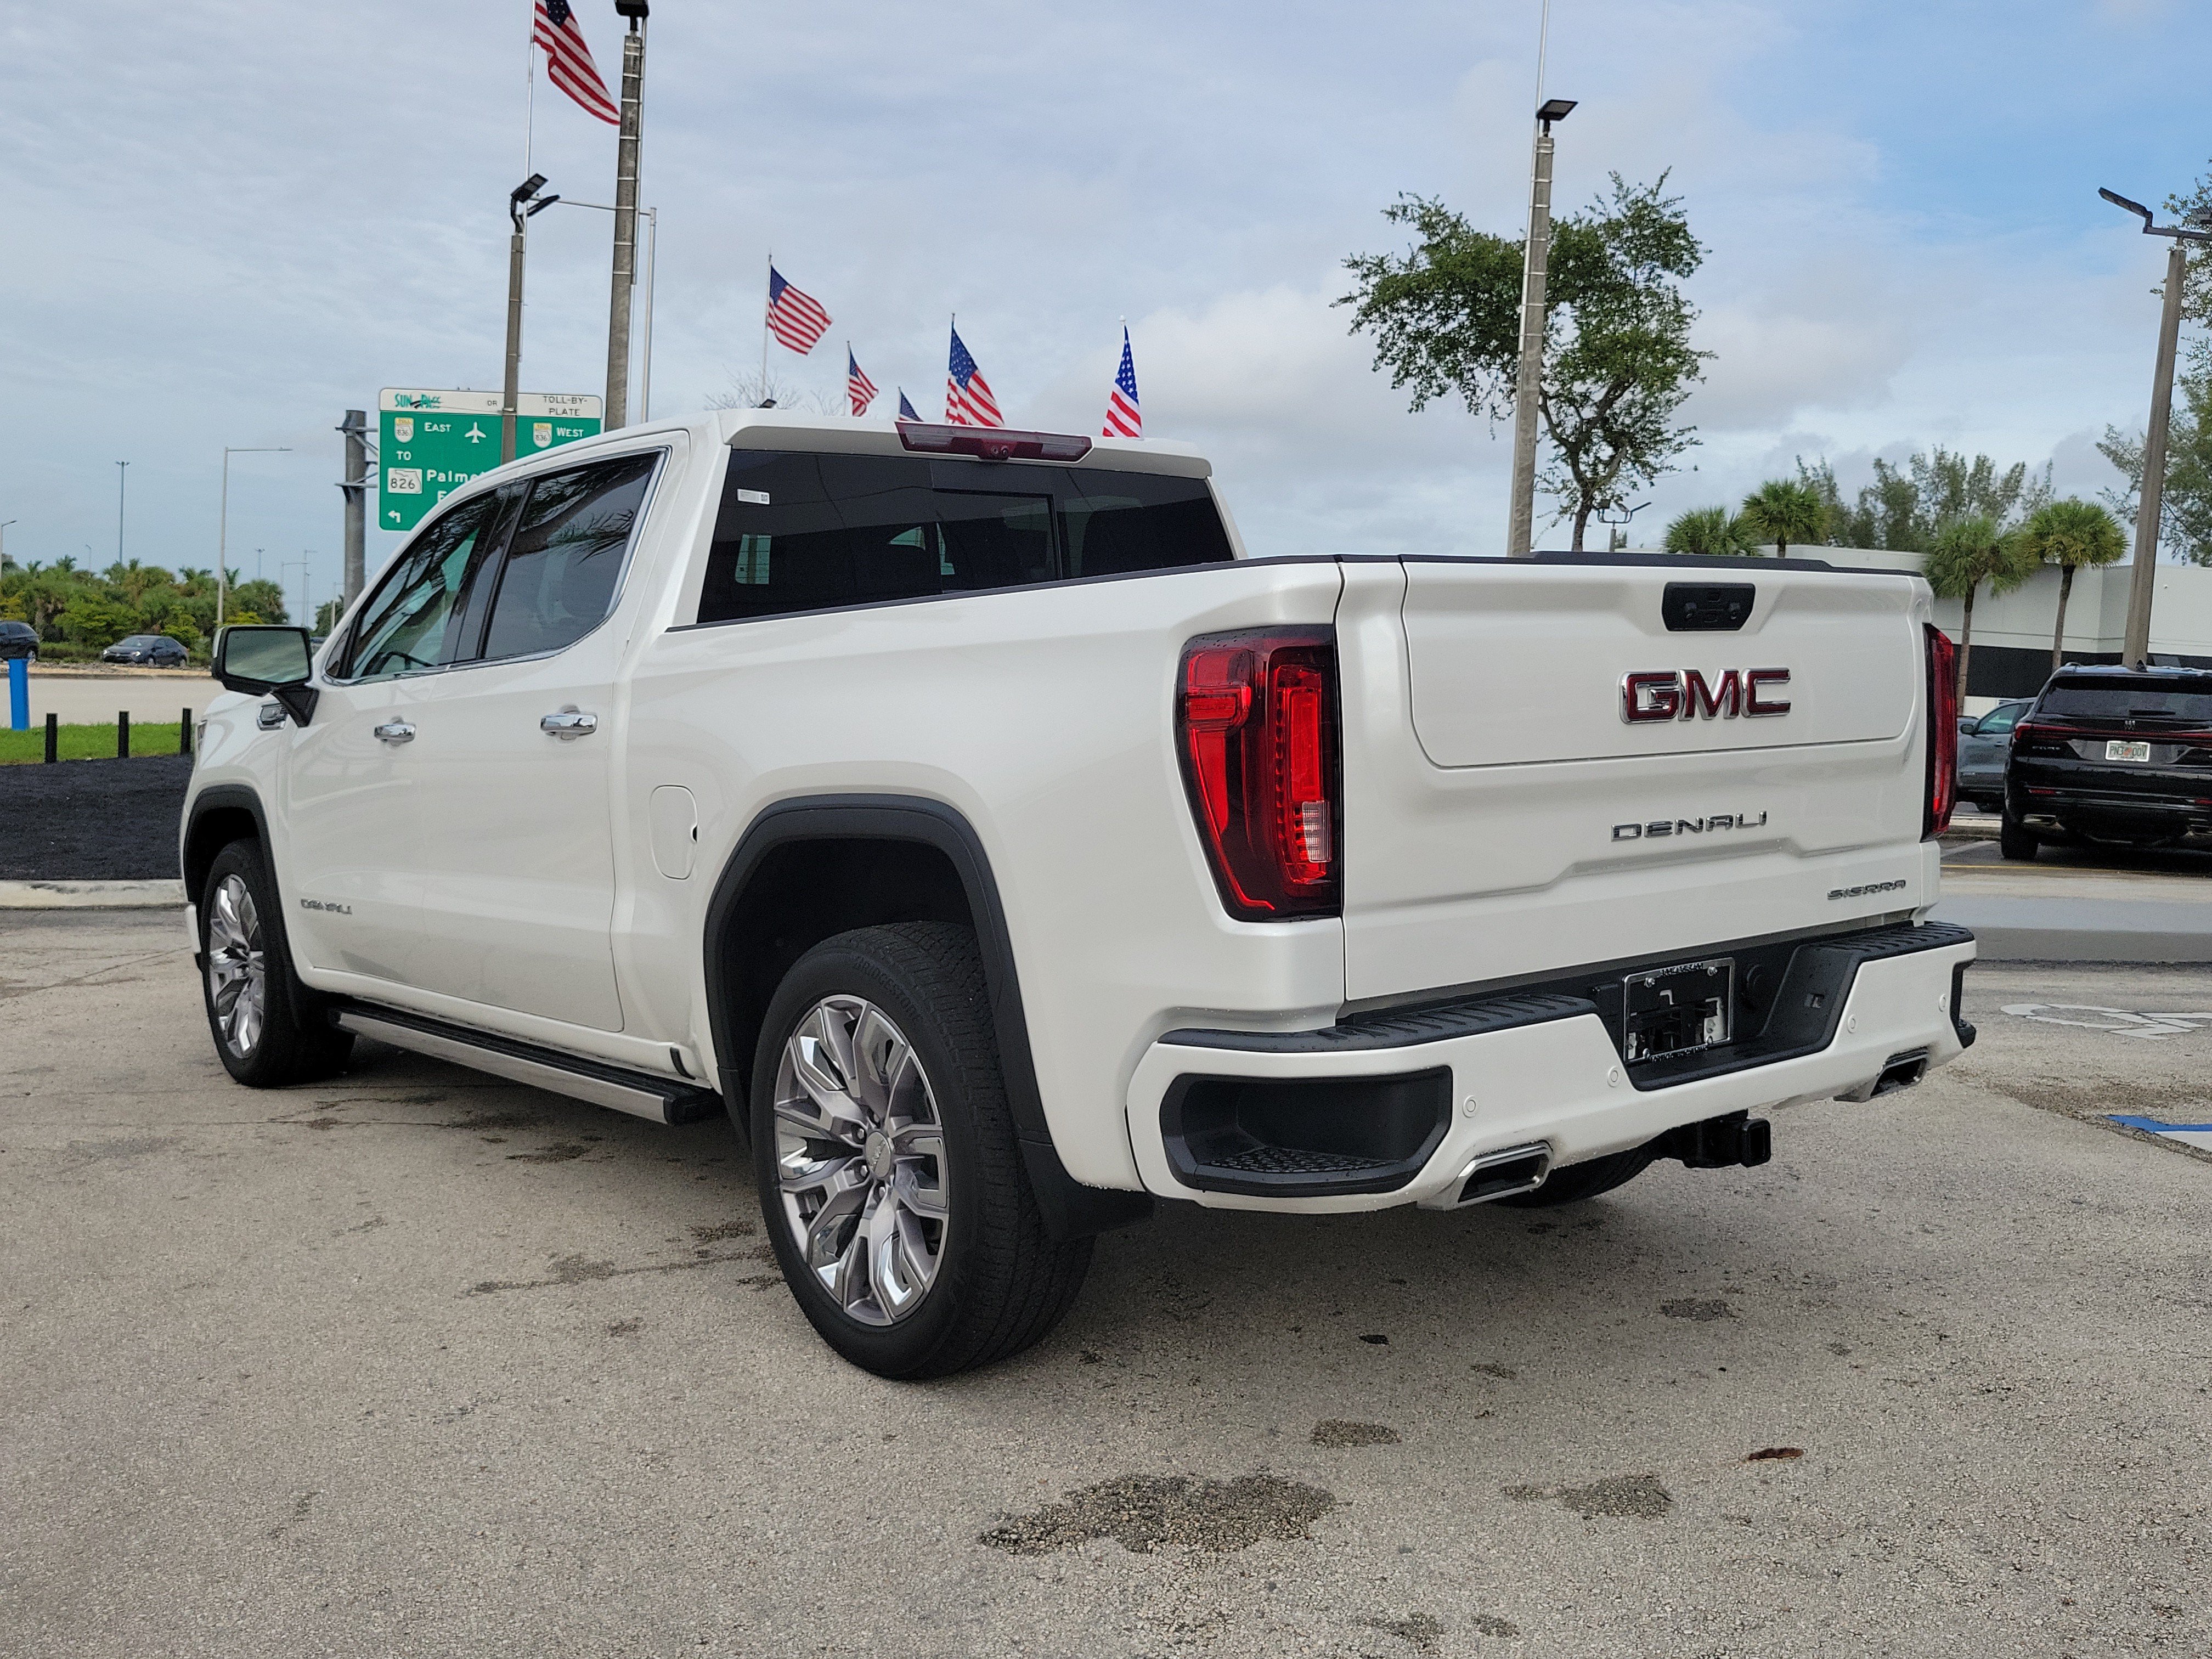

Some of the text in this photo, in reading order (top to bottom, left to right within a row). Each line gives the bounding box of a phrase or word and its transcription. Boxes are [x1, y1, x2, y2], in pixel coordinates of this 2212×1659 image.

[549, 408, 580, 416] PLATE
[424, 422, 452, 432] EAST
[556, 427, 584, 437] WEST
[396, 450, 412, 461] TO
[390, 478, 416, 489] 826
[1619, 667, 1791, 725] GMC
[1611, 810, 1767, 842] DENALI
[1827, 879, 1906, 900] SIERRA
